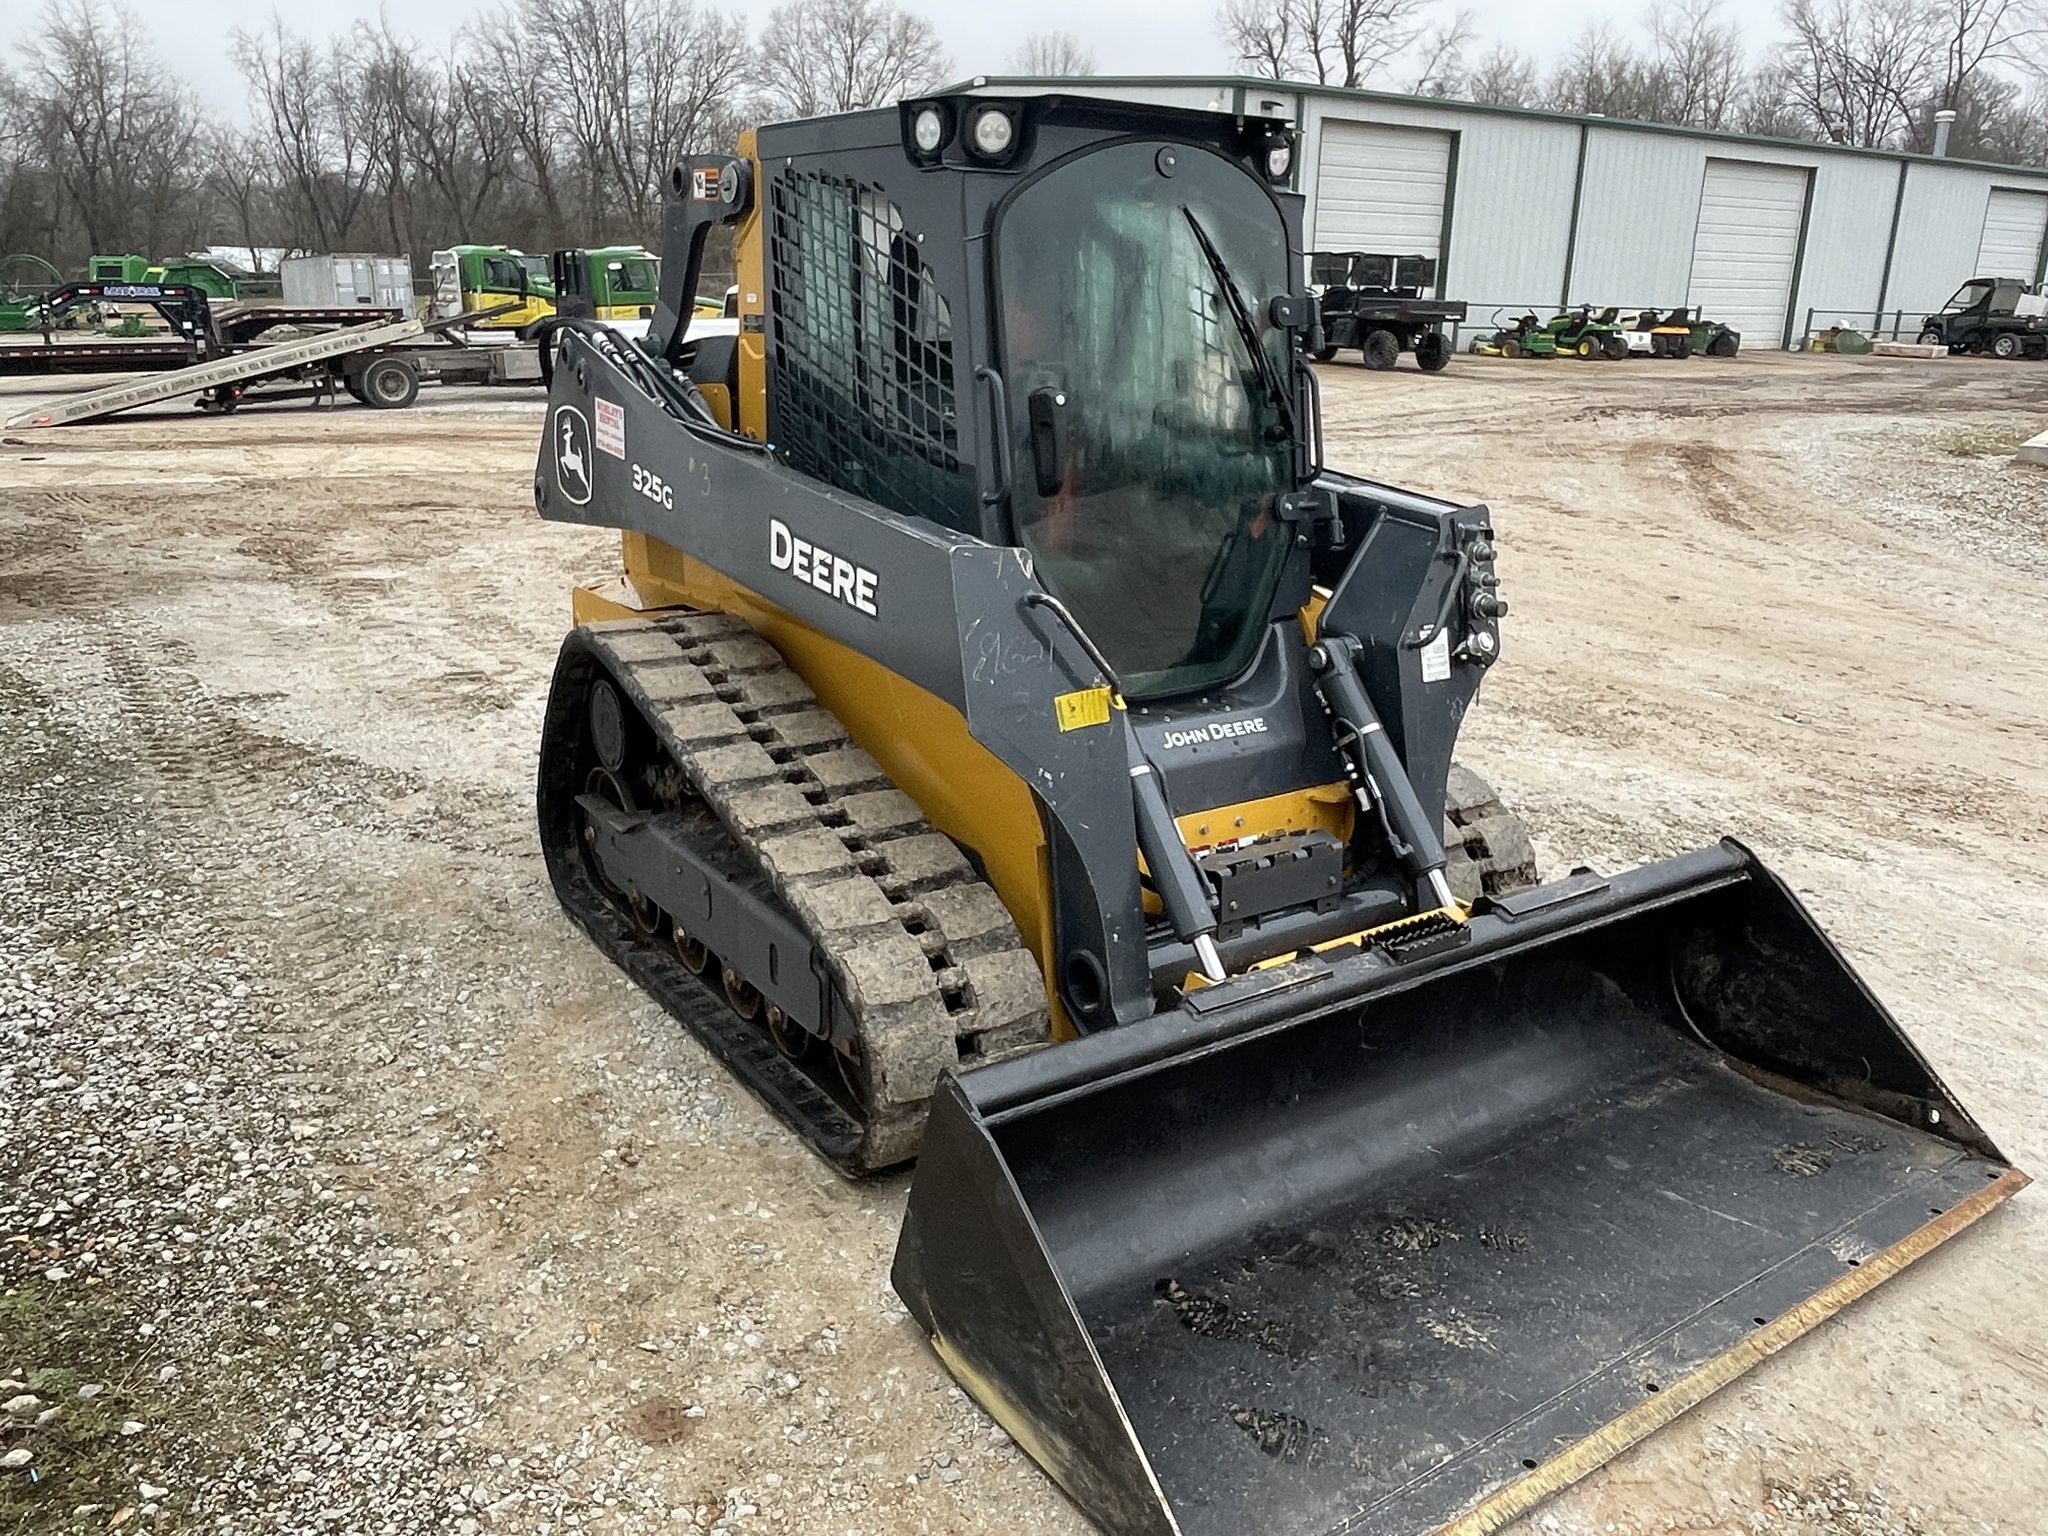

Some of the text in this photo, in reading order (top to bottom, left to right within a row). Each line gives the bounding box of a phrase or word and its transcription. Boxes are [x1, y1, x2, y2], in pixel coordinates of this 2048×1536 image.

[632, 463, 673, 510] 325G
[770, 519, 878, 617] DEERE
[1163, 717, 1268, 749] JOHN DEERE
